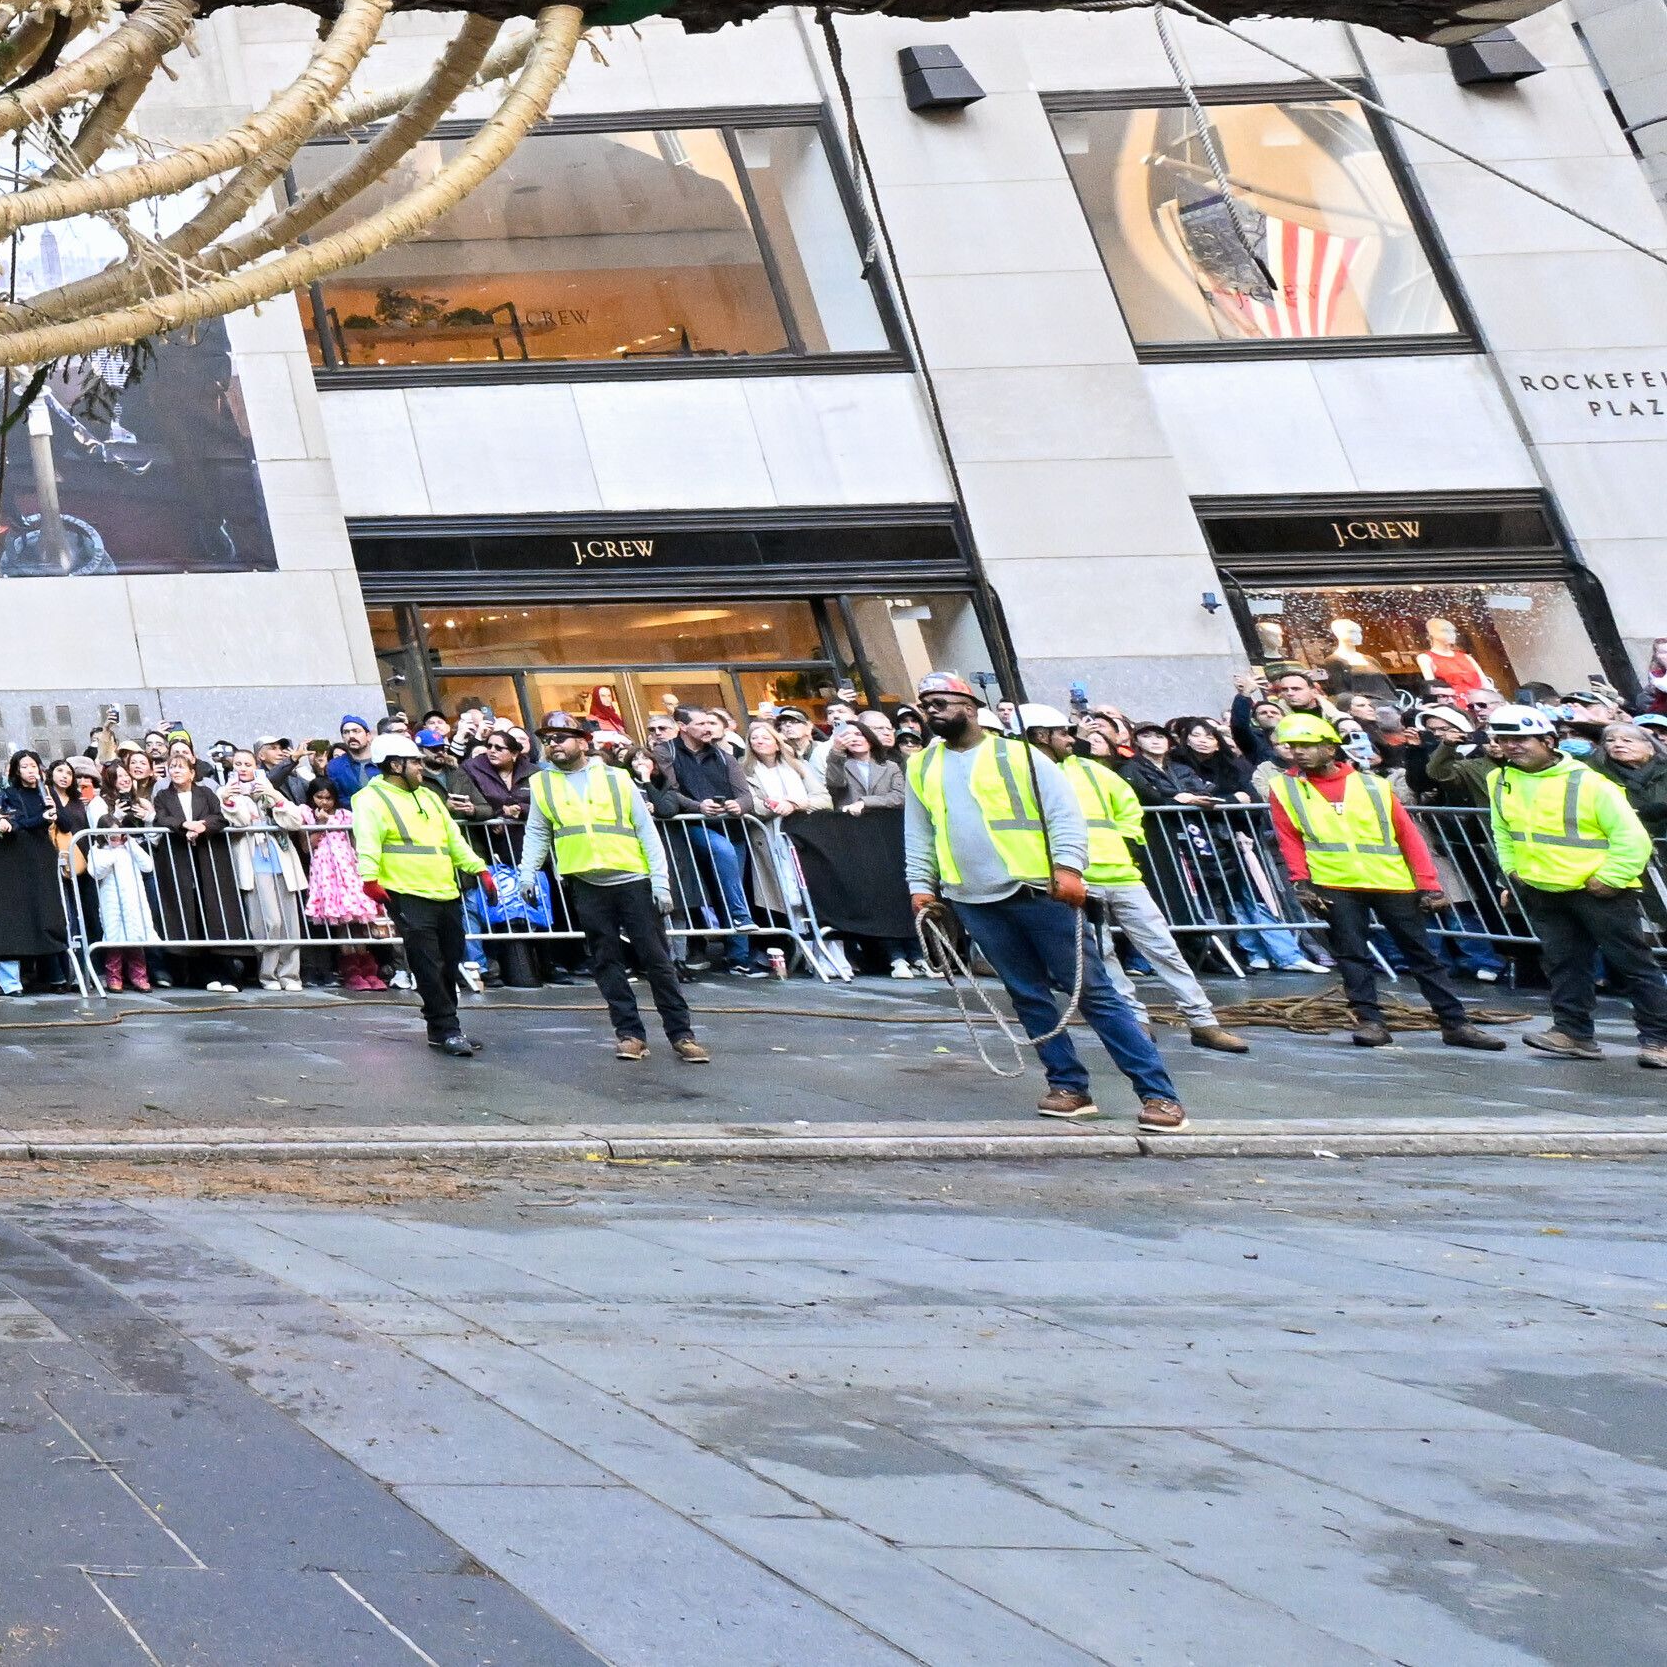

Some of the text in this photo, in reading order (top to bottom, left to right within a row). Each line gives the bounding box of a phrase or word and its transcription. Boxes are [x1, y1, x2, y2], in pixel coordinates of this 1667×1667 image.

[522, 309, 589, 326] CREW
[1587, 399, 1664, 417] PLAZ
[1330, 520, 1420, 547] J.CREW
[571, 540, 654, 566] J.CREW
